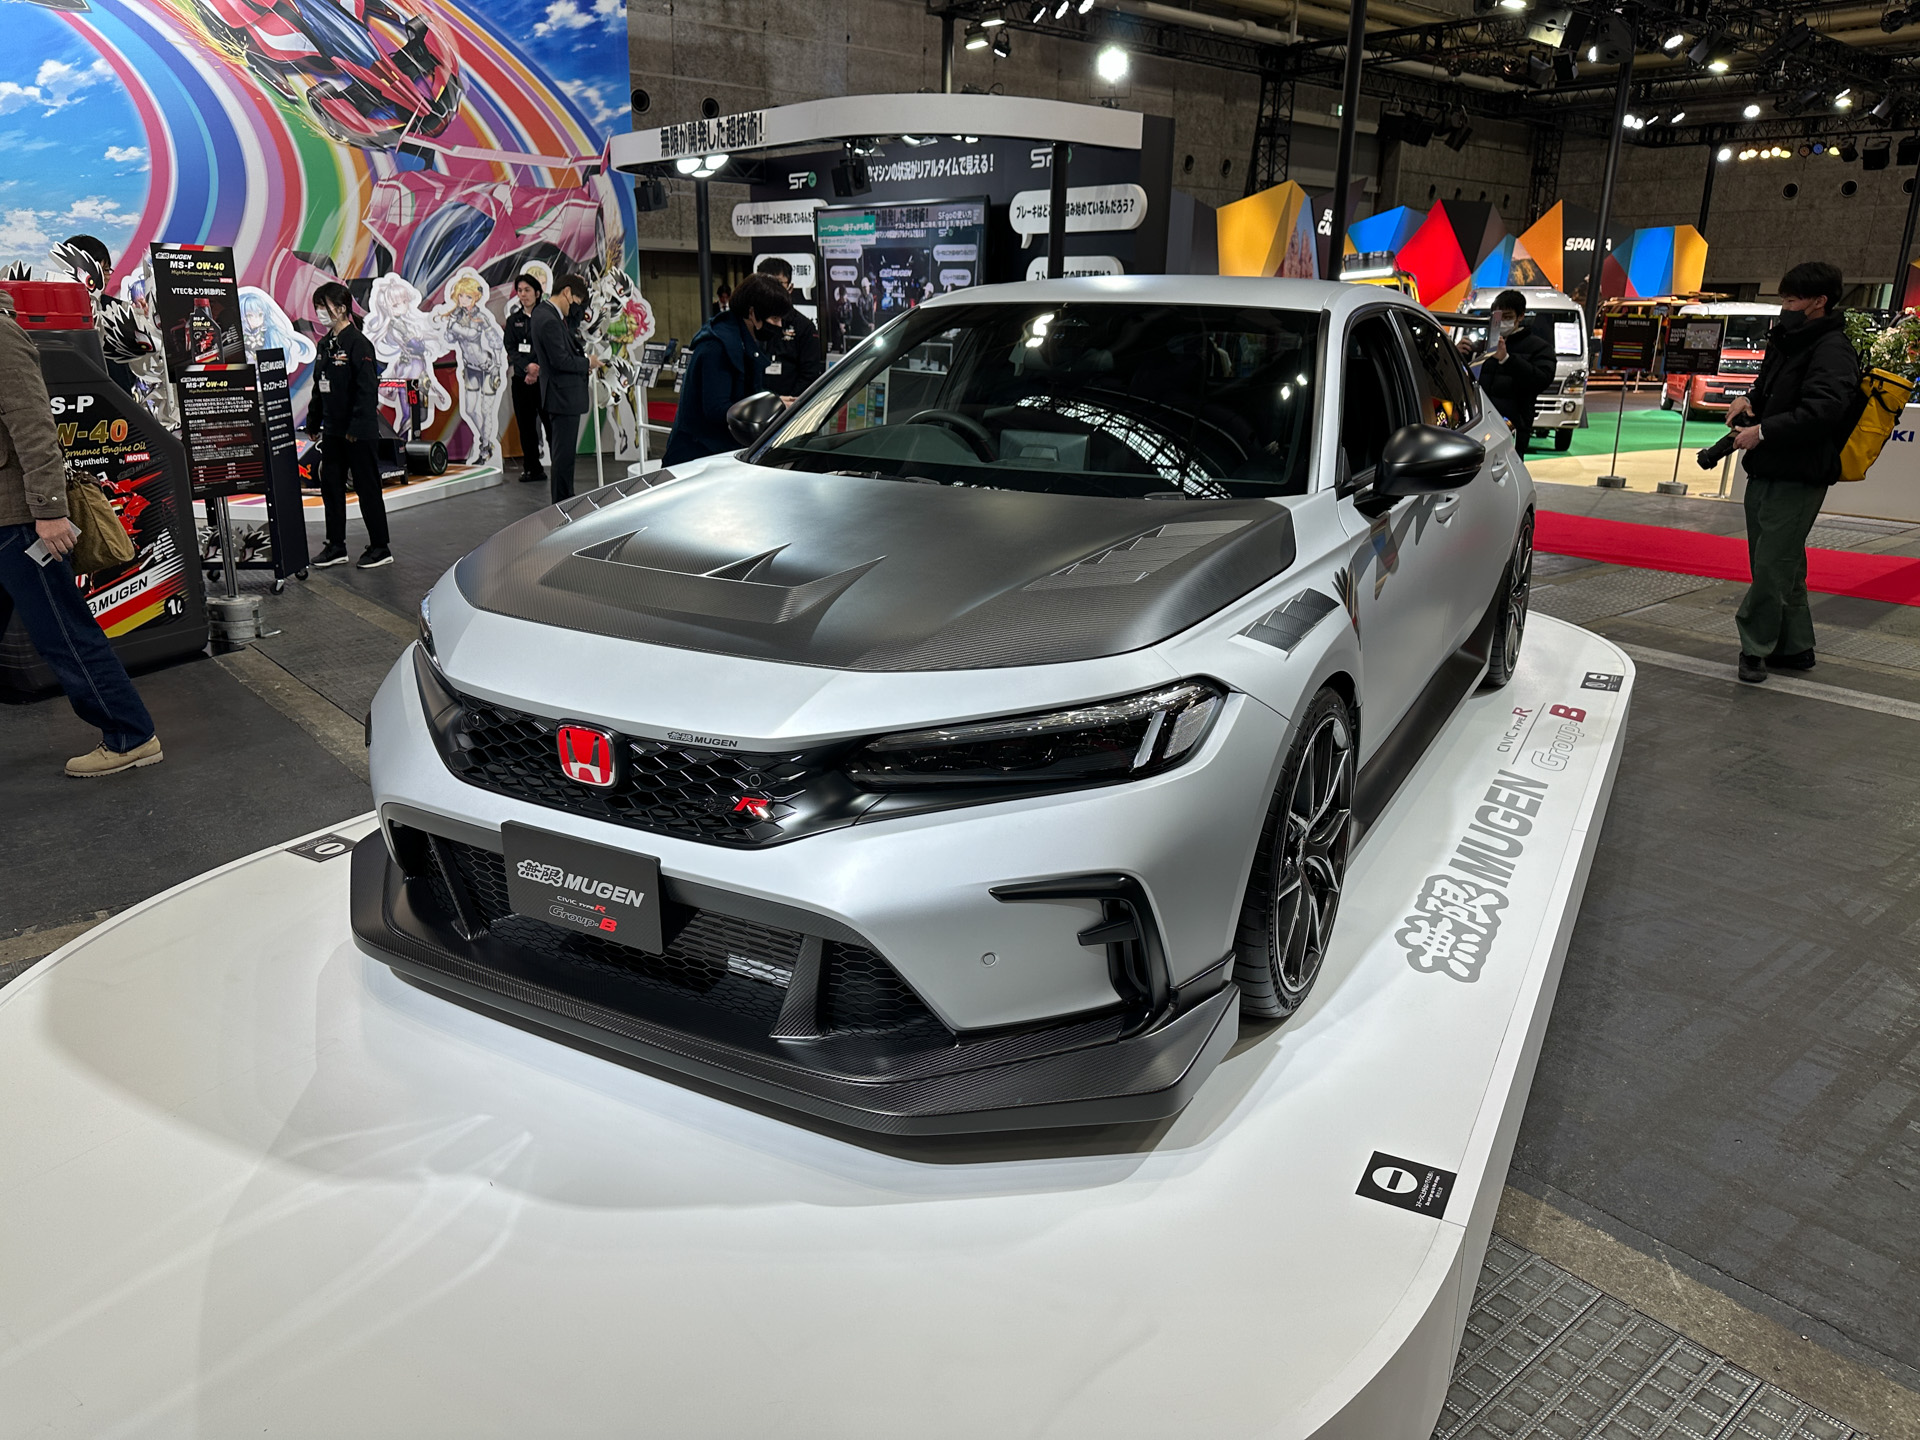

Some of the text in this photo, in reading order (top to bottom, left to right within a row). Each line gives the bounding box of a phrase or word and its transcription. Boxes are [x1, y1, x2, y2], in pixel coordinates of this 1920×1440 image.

[50, 395, 94, 415] S-P
[57, 419, 128, 447] W-40
[102, 444, 132, 455] Engine
[133, 441, 147, 450] Oil
[74, 456, 109, 468] Synthetic
[126, 453, 150, 462] MOTUL
[98, 575, 149, 612] MUGEN
[694, 735, 739, 748] MUGEN
[516, 859, 645, 908] 無限 MUGEN
[1394, 768, 1549, 984] 無限 MUGEN
[556, 895, 577, 906] CIVIC
[578, 902, 595, 911] TYPE
